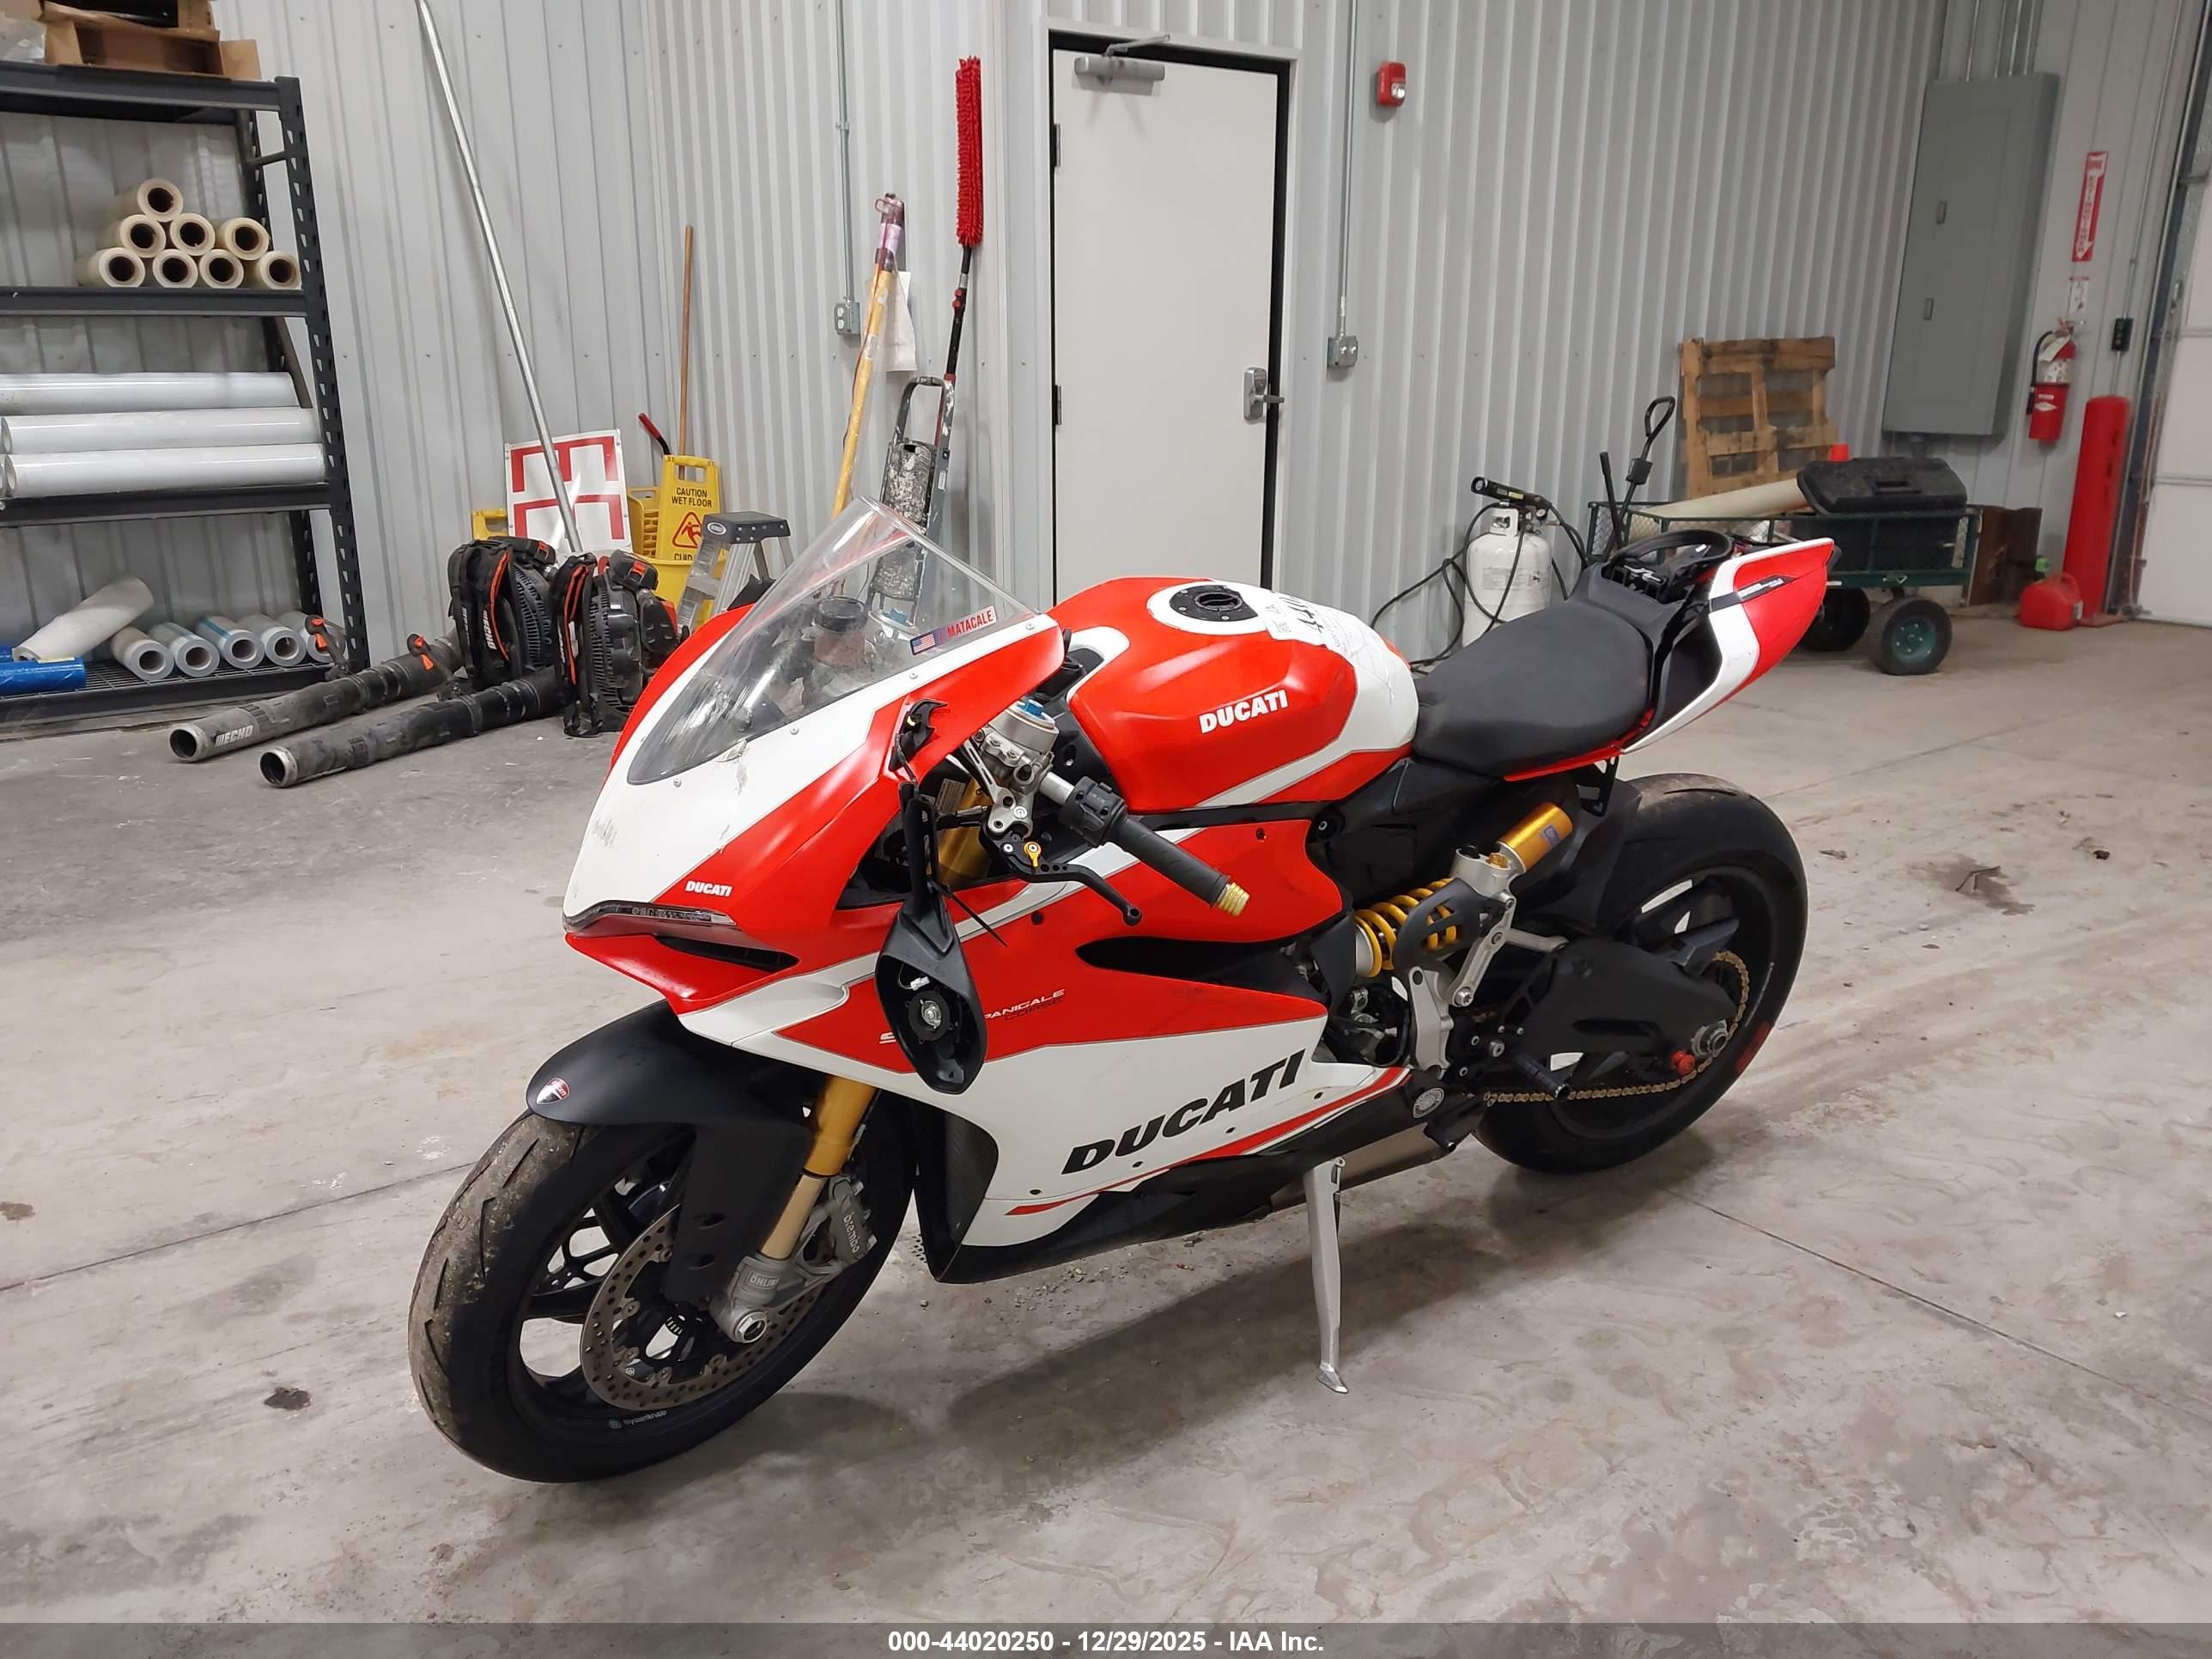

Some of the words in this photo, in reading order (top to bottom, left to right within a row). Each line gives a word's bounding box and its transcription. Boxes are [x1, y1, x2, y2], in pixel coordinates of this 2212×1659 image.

[672, 495, 688, 506] WET
[689, 499, 713, 508] FLOOR
[676, 487, 708, 498] CAUTION
[947, 610, 994, 639] MATACALE
[1199, 689, 1288, 734] DUCATI
[224, 725, 254, 744] ECHO
[685, 880, 733, 897] DUCATI
[1060, 1048, 1306, 1176] DUCATI
[842, 1212, 860, 1254] brembo
